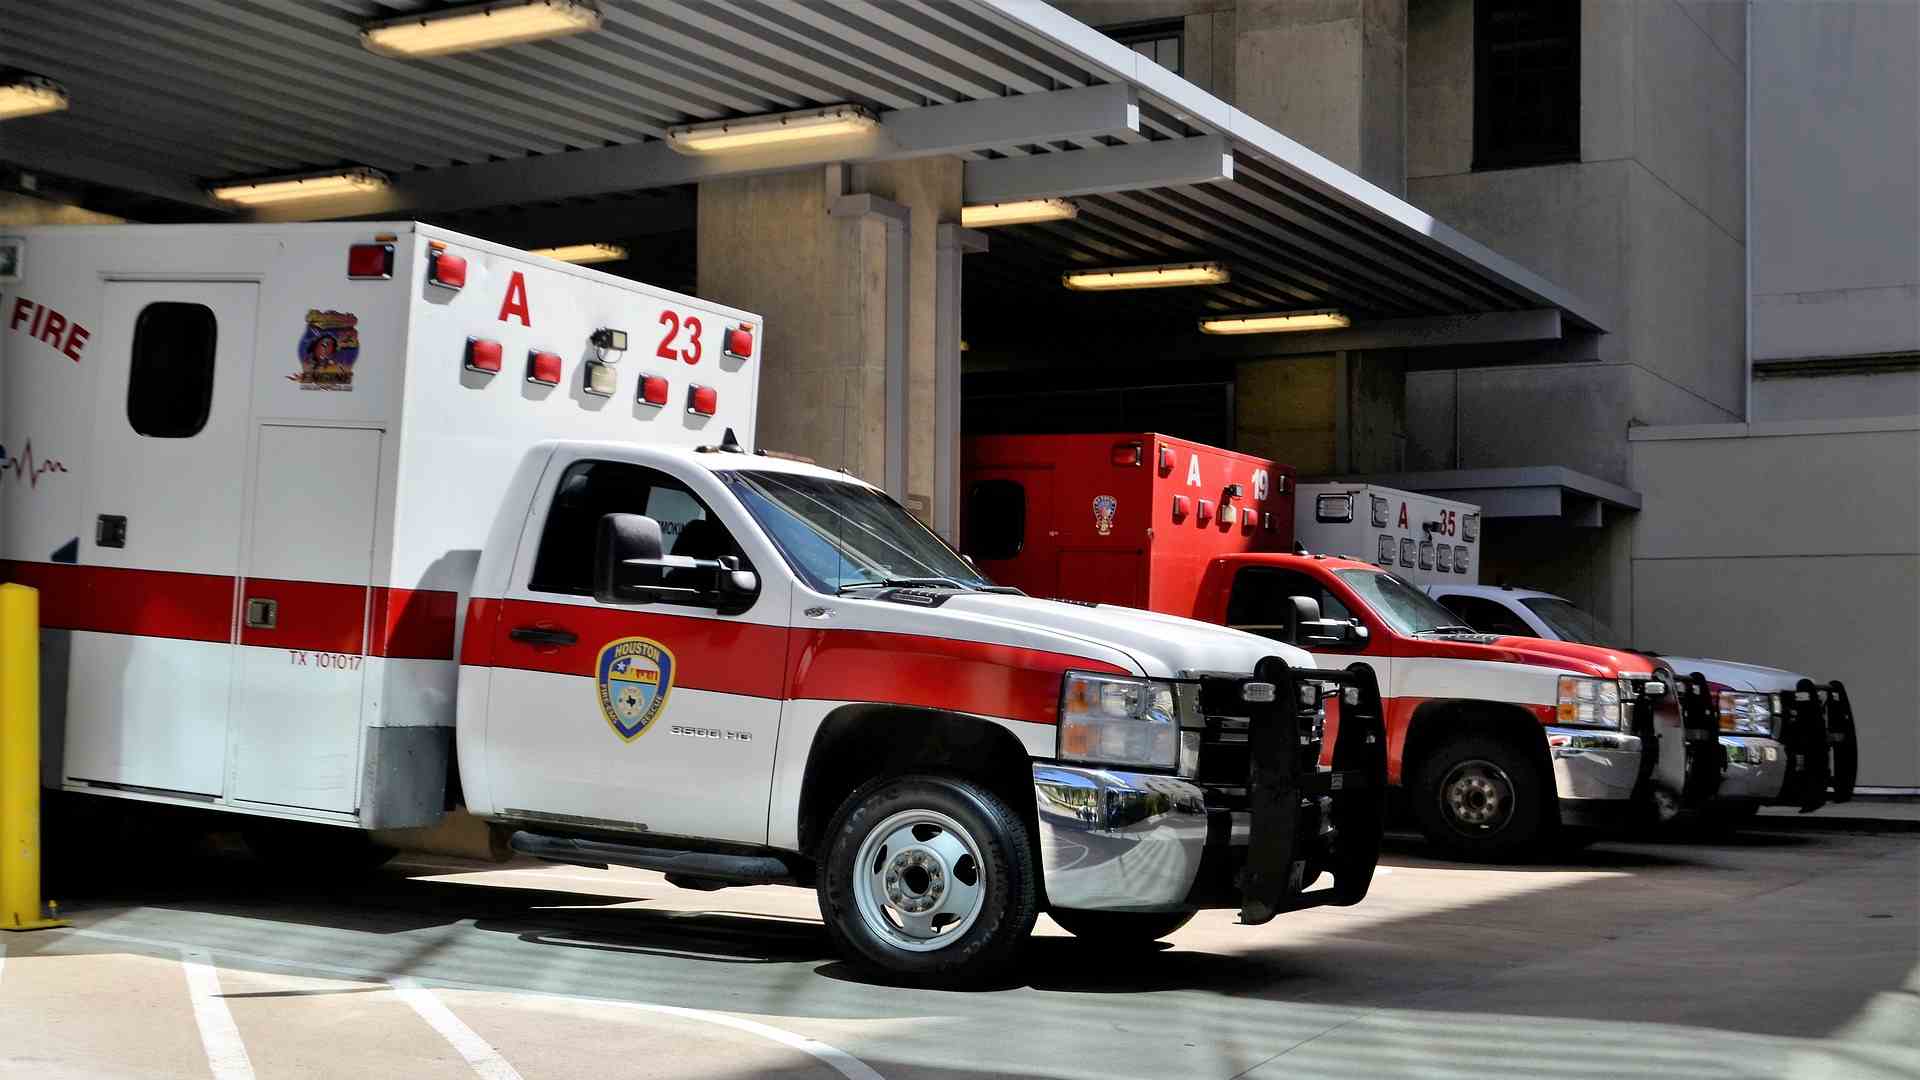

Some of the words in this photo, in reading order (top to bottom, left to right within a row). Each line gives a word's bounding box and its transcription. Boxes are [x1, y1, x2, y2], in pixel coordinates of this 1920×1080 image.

[9, 296, 91, 363] FIRE
[498, 271, 531, 328] A
[656, 309, 703, 365] 23
[1186, 454, 1202, 488] A
[1251, 468, 1270, 501] 19
[1397, 501, 1409, 530] A
[1439, 509, 1457, 537] 35
[288, 650, 307, 666] TX
[315, 654, 363, 671] 101017
[614, 642, 660, 662] HOUSTON
